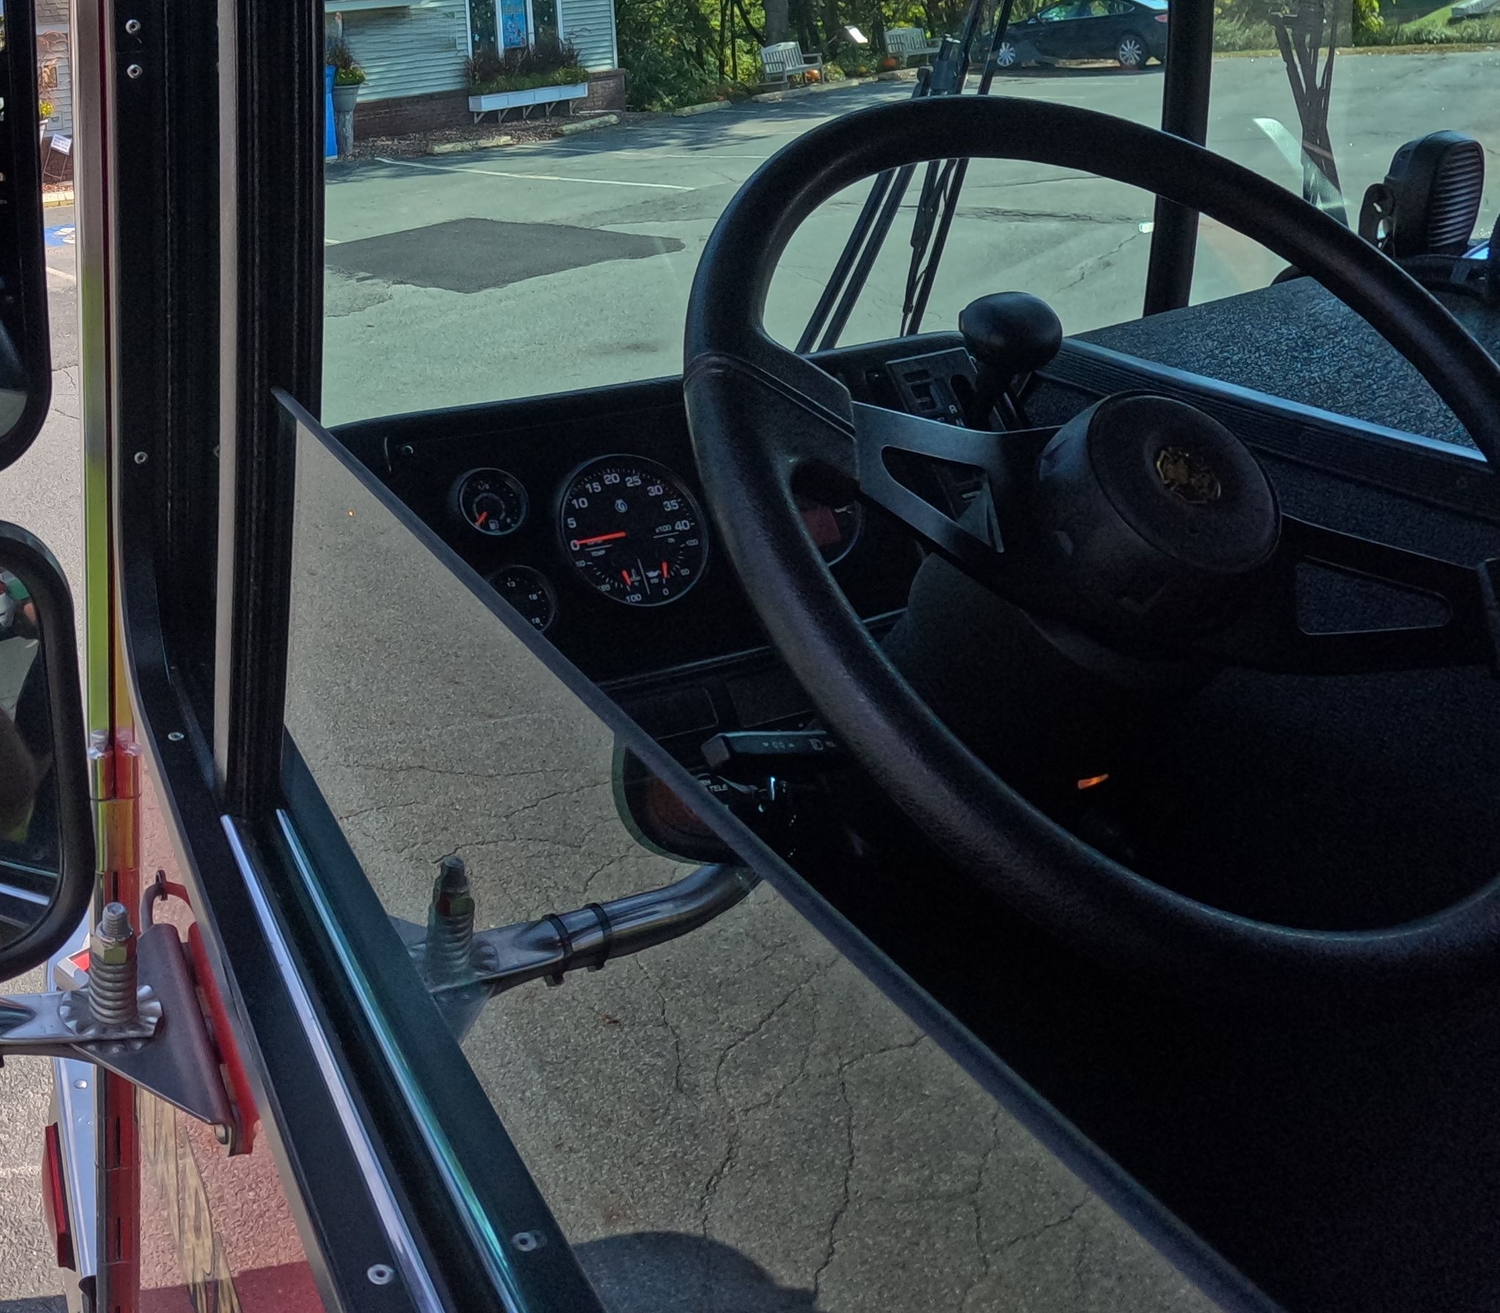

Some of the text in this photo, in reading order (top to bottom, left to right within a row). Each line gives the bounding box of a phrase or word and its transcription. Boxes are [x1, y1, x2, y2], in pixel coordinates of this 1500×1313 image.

[603, 473, 620, 485] 20
[625, 475, 642, 487] 25
[585, 482, 602, 494] 15
[647, 485, 664, 497] 30
[571, 497, 588, 509] 10
[663, 500, 679, 512] 35
[567, 517, 577, 529] 5
[674, 519, 691, 531] 40
[625, 593, 642, 603] 100
[662, 588, 670, 596] 0
